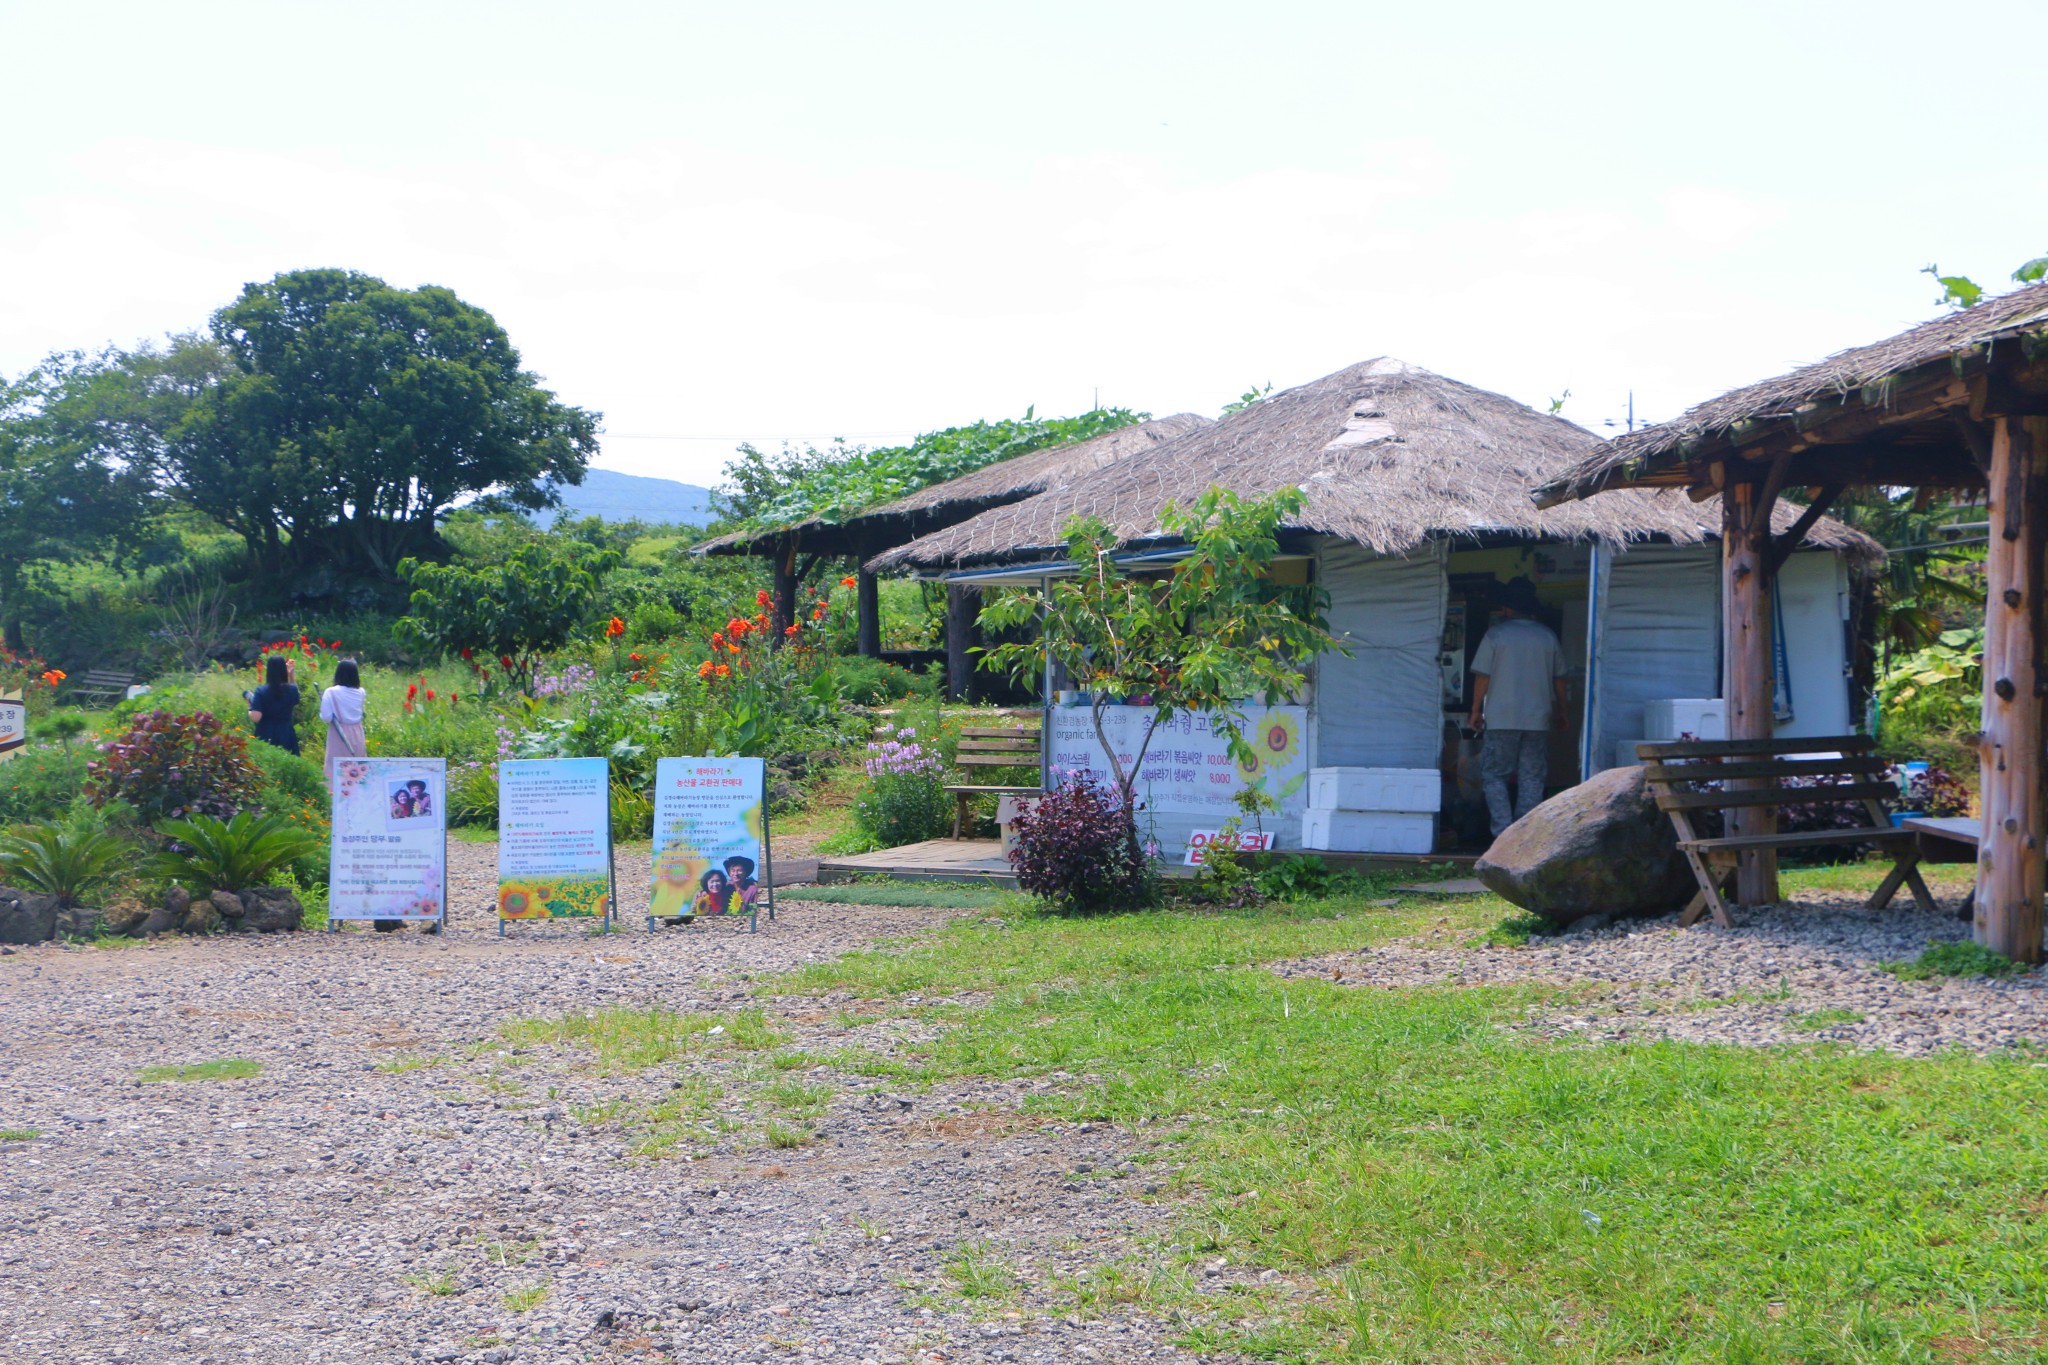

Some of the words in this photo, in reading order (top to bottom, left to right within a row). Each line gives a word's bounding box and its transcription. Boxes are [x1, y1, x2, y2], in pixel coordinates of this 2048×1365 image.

[1056, 715, 1088, 727] 친환경농장
[1056, 729, 1085, 741] organic
[1086, 728, 1100, 740] far
[1056, 752, 1091, 766] 아이스크림
[1144, 749, 1172, 763] 해바라기
[1174, 750, 1202, 765] 볶음씨앗
[1207, 754, 1232, 766] 10,000
[696, 767, 724, 775] 해바라기
[1141, 767, 1172, 782] 해바라기
[1174, 768, 1196, 783] 생씨앗
[1209, 772, 1231, 784] 8,000
[676, 778, 697, 787] 농산물
[699, 778, 720, 787] 교환권
[721, 778, 743, 787] 판매대
[341, 835, 369, 843] 농장주인
